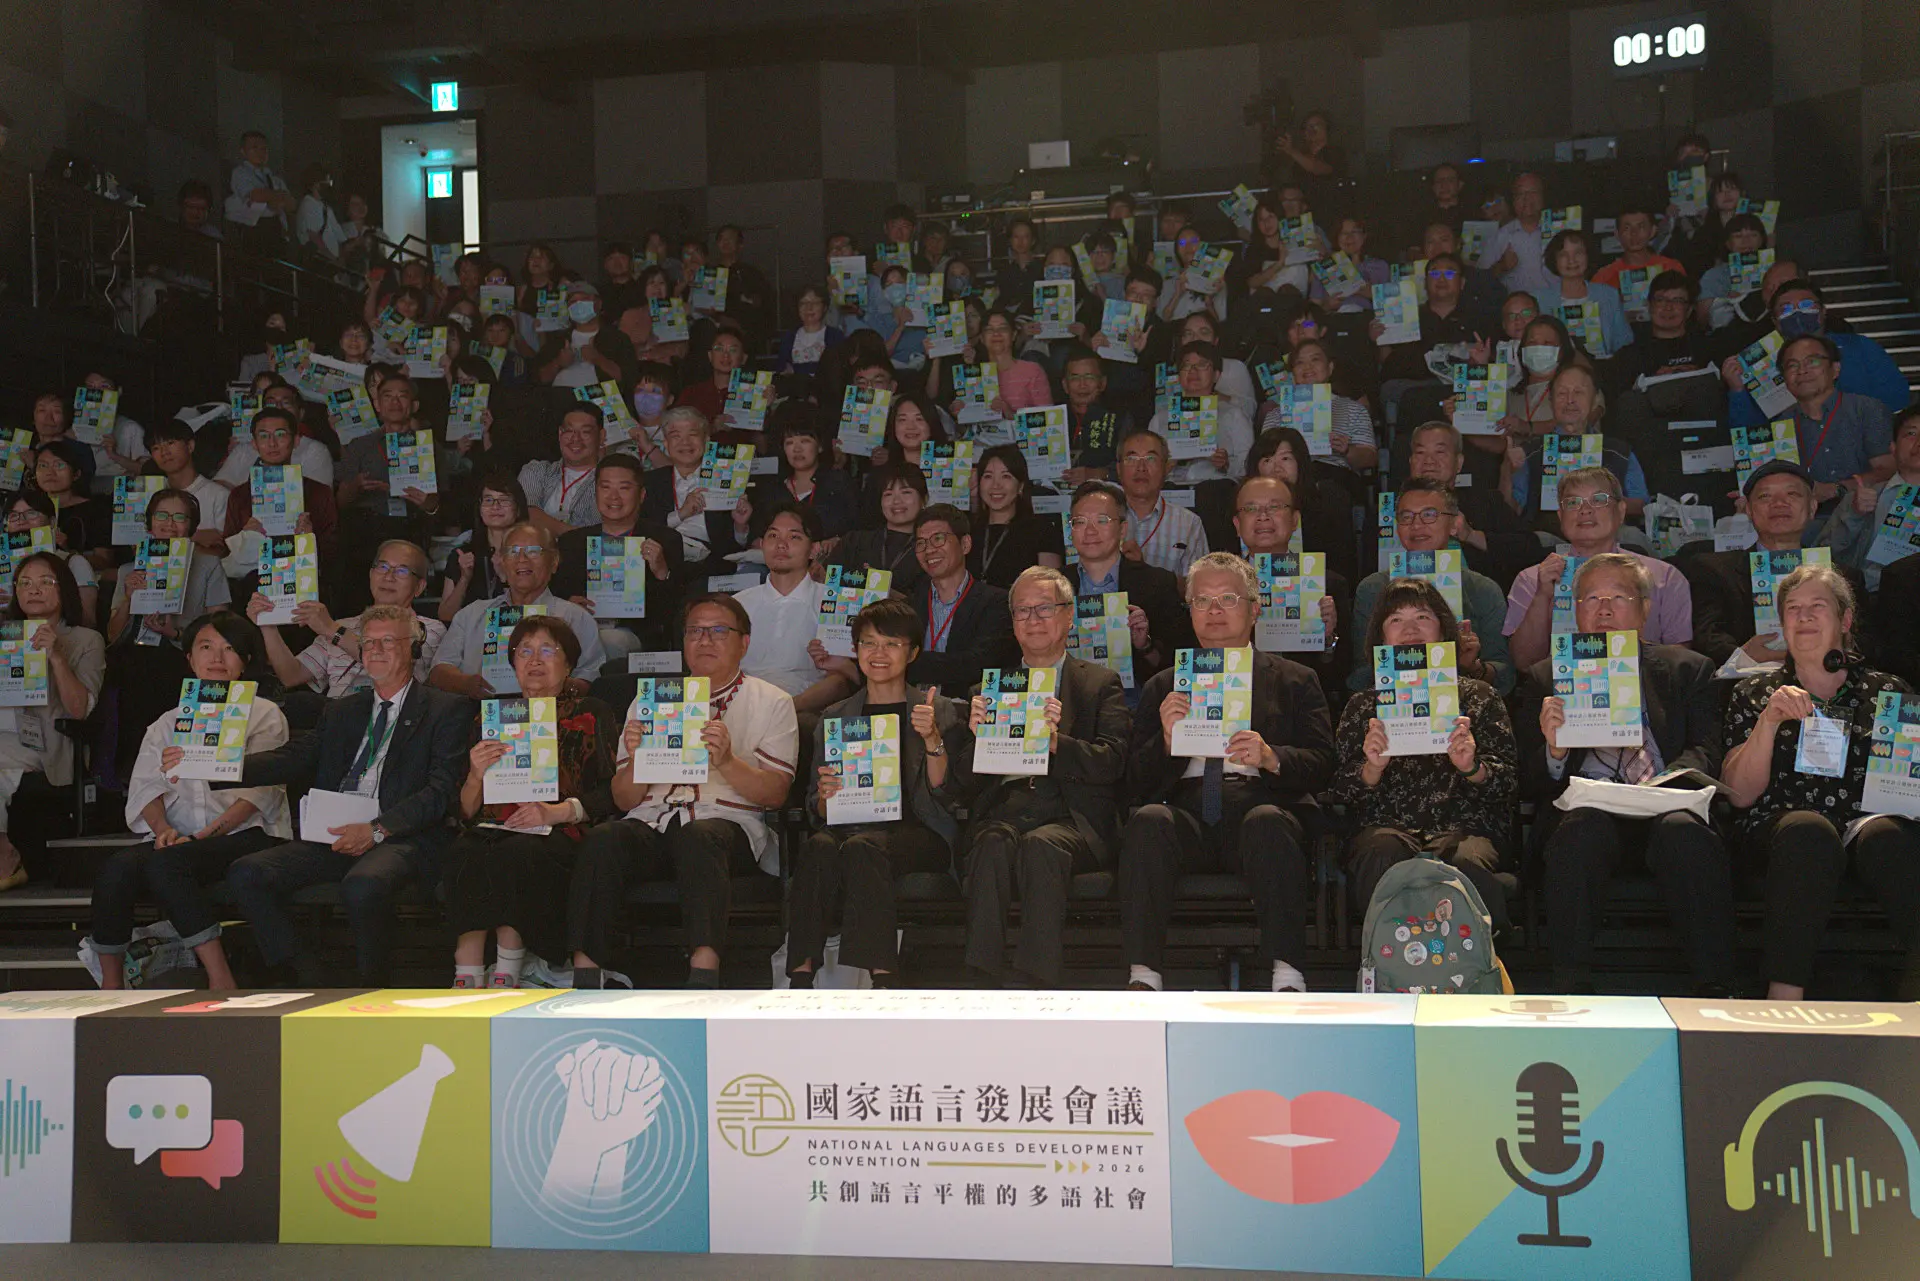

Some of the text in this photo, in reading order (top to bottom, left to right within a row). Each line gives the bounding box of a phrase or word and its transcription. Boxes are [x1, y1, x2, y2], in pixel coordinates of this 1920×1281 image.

[1613, 23, 1705, 66] 00:00
[806, 1081, 1145, 1126] 國家語言發展會議
[808, 1139, 1145, 1156] NATIONAL LANGUAGES DEVELOPMENT
[808, 1156, 1145, 1174] CONVENTION 2026
[808, 1180, 1147, 1210] 共創語言平權的多語社會
